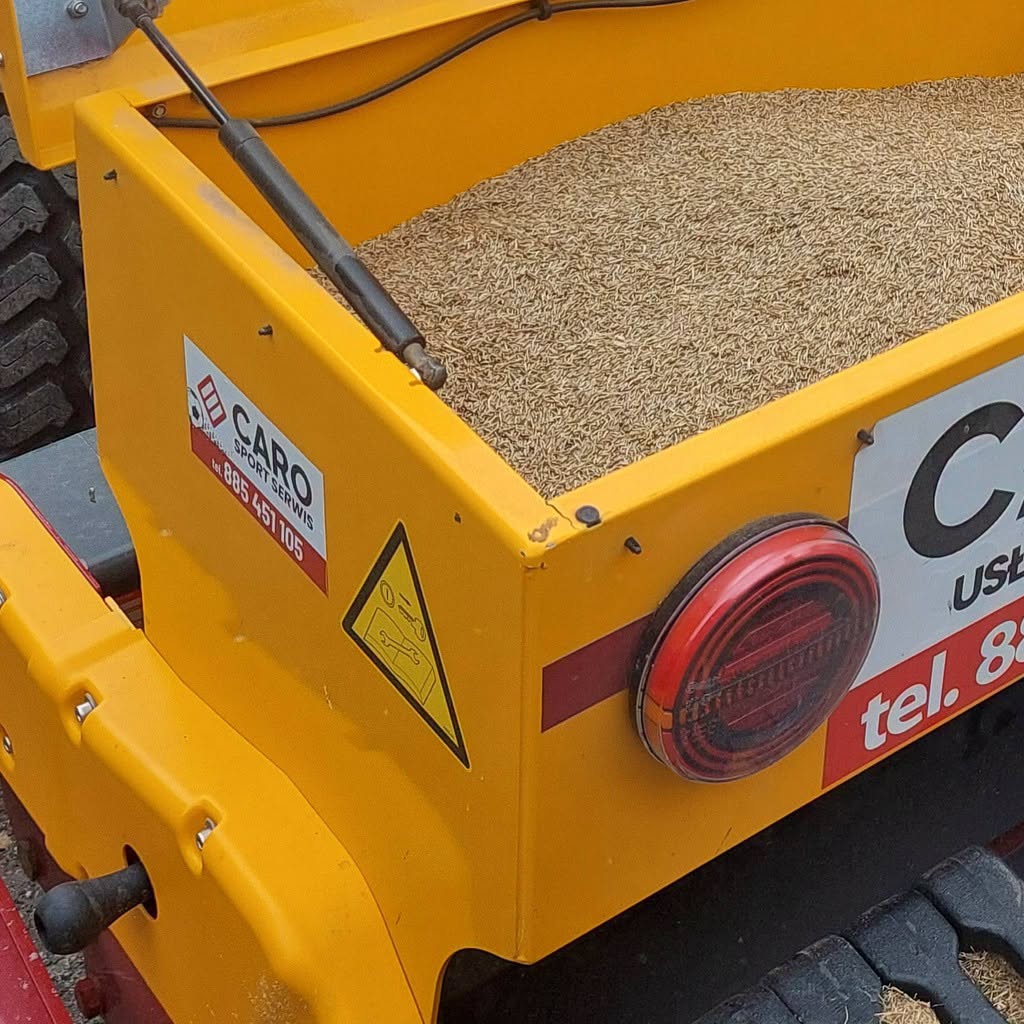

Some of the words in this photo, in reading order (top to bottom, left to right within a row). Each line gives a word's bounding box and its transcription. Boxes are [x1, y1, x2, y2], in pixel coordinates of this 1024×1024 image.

[232, 403, 313, 508] CARO
[233, 437, 269, 484] SPORT
[270, 478, 314, 532] SERWIS
[211, 457, 223, 476] tel.
[223, 461, 250, 504] 885
[251, 494, 277, 533] 451
[279, 519, 304, 562] 105
[860, 650, 960, 752] tel.
